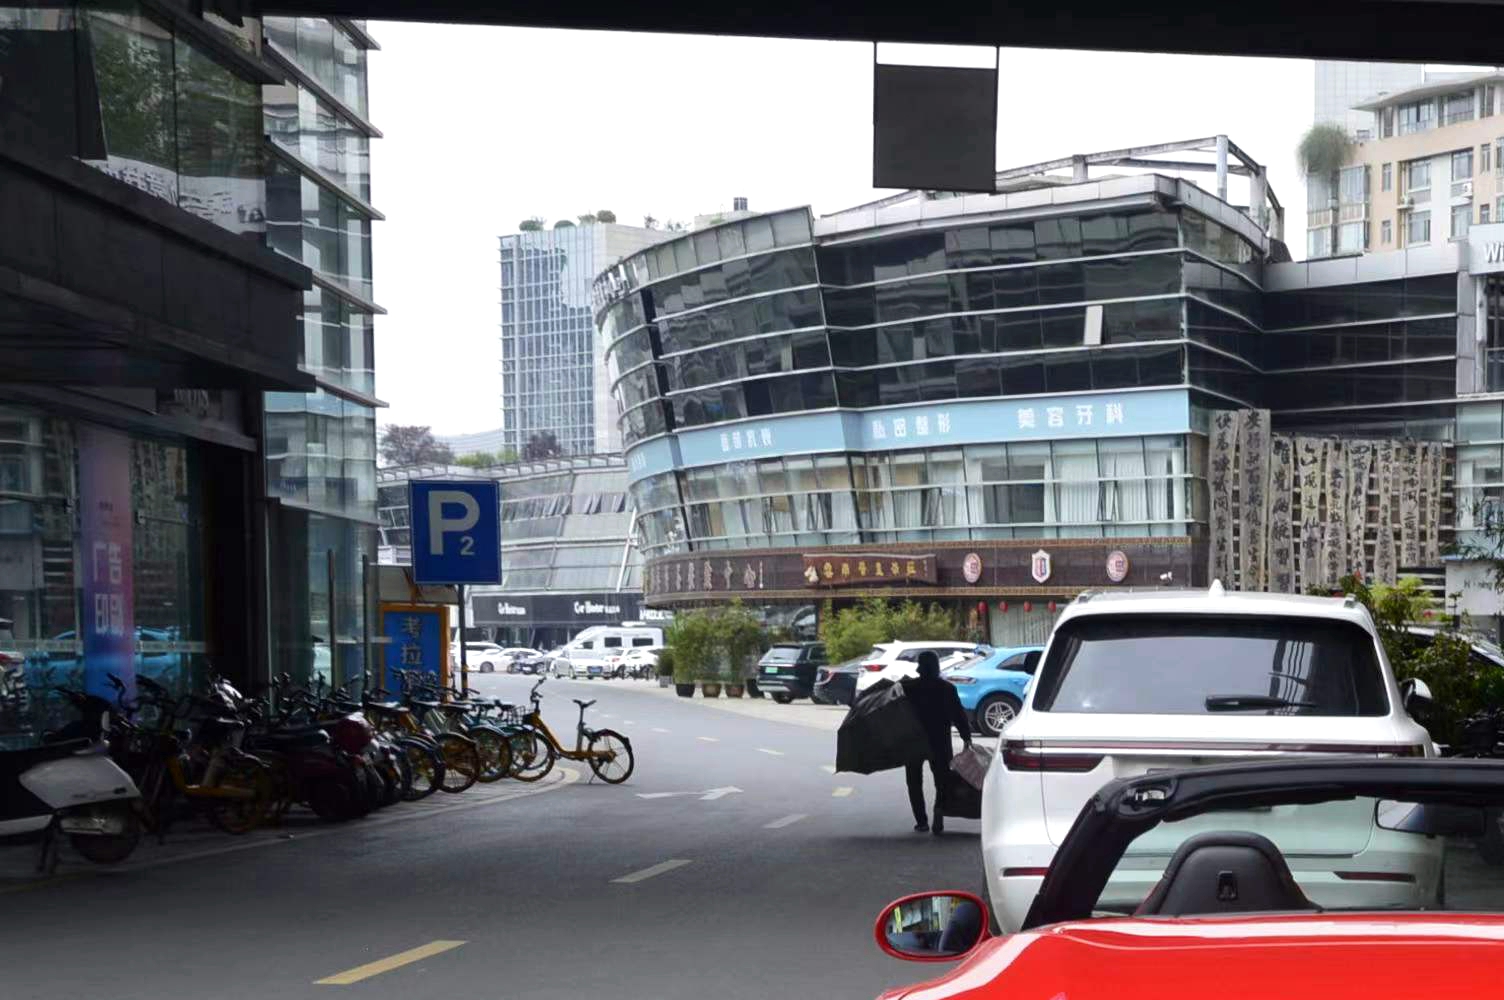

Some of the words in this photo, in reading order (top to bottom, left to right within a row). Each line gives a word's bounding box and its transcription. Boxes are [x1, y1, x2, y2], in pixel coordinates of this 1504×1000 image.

[1017, 403, 1125, 429] 美容牙科
[428, 490, 480, 556] P
[460, 536, 476, 556] 2
